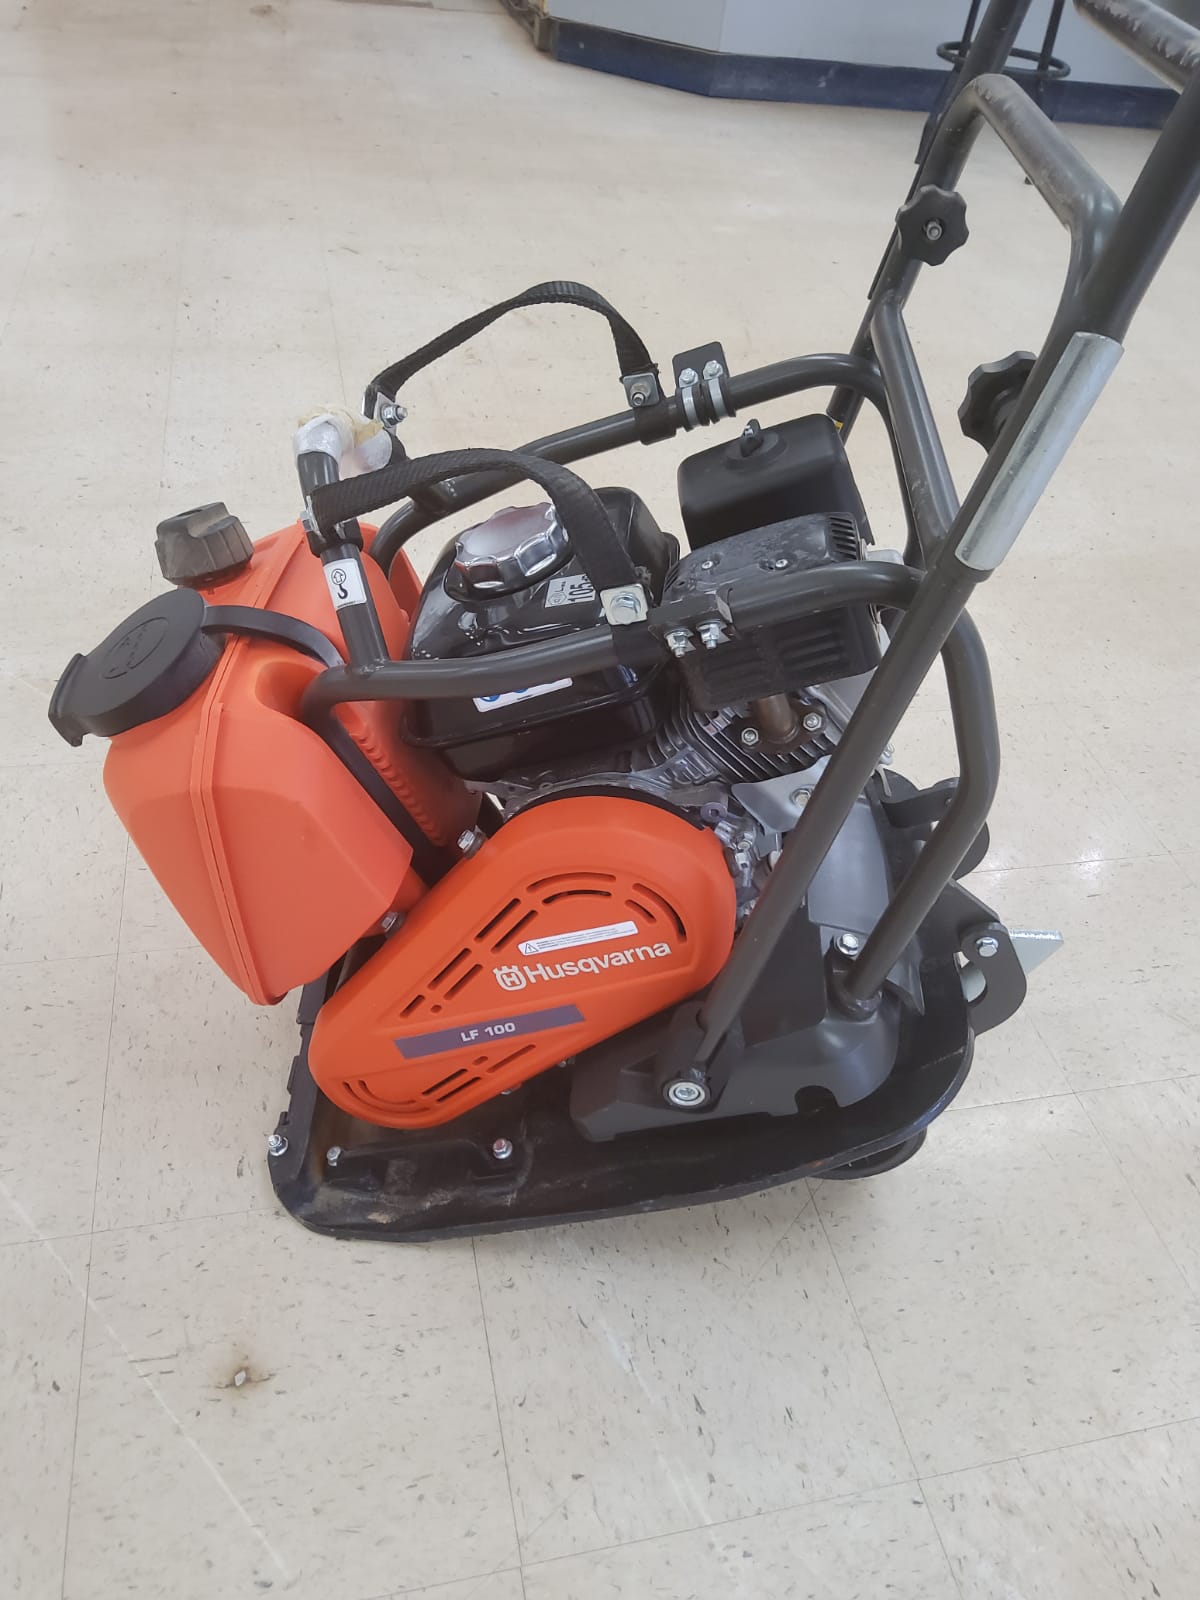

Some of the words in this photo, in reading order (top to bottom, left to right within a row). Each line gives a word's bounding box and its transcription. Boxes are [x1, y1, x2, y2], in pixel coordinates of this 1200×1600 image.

[567, 581, 594, 602] 105
[523, 942, 672, 984] Husqvarna
[460, 1029, 480, 1042] LF
[484, 1022, 516, 1036] 100
